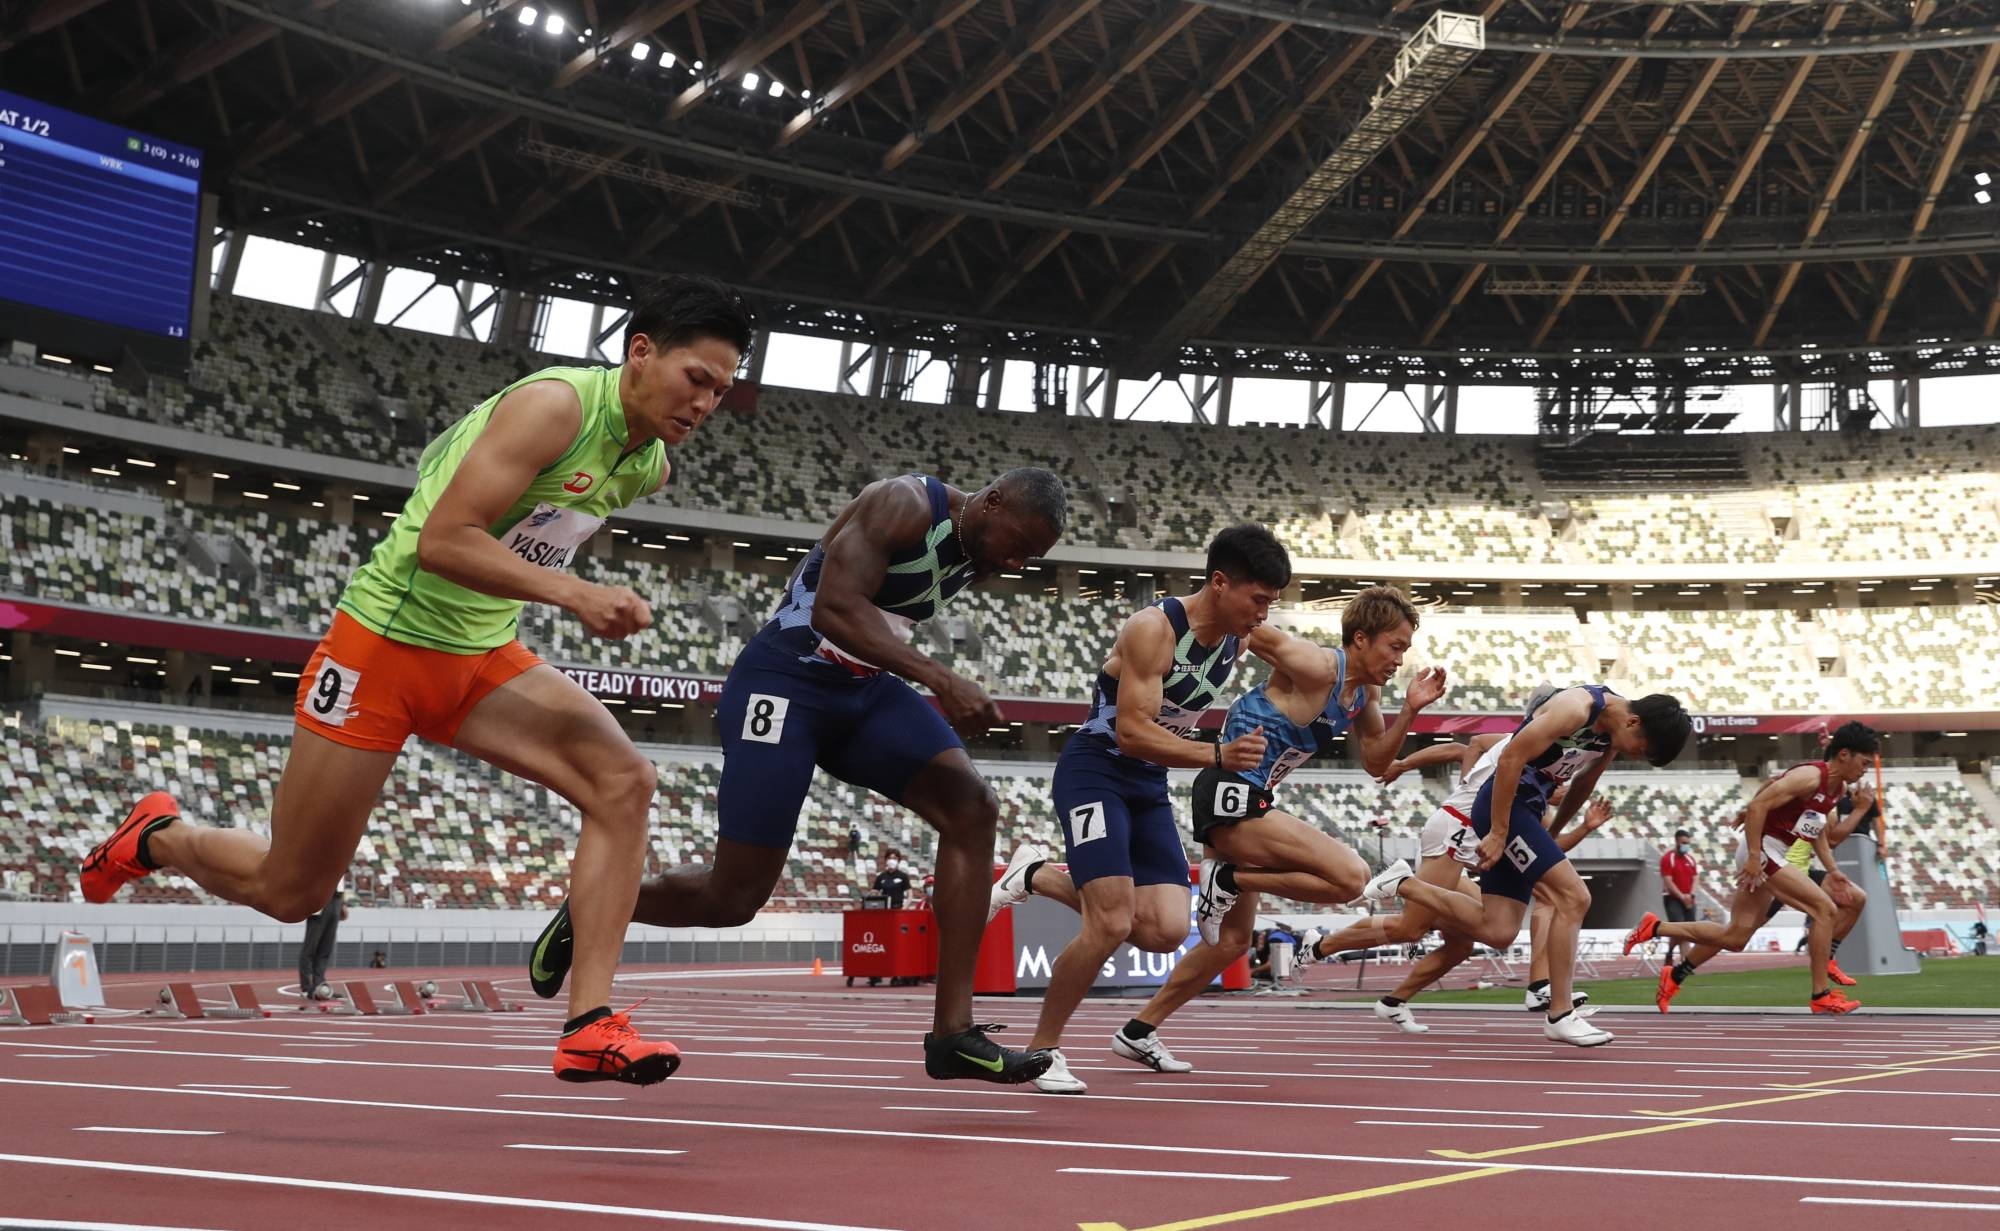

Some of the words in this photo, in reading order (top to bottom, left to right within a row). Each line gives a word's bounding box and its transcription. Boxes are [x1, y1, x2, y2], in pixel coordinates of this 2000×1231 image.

[22, 116, 50, 137] 1/2
[563, 471, 593, 494] D
[313, 667, 342, 714] 9
[639, 676, 700, 700] TOKYO
[703, 681, 723, 693] Test
[750, 699, 775, 737] 8
[1707, 716, 1726, 726] Test
[1727, 716, 1758, 726] Events
[1221, 786, 1240, 813] 6
[1075, 807, 1095, 839] 7
[1451, 828, 1467, 847] 4
[1509, 842, 1530, 865] 5
[852, 943, 885, 953] OMEGA
[71, 954, 88, 988] 1
